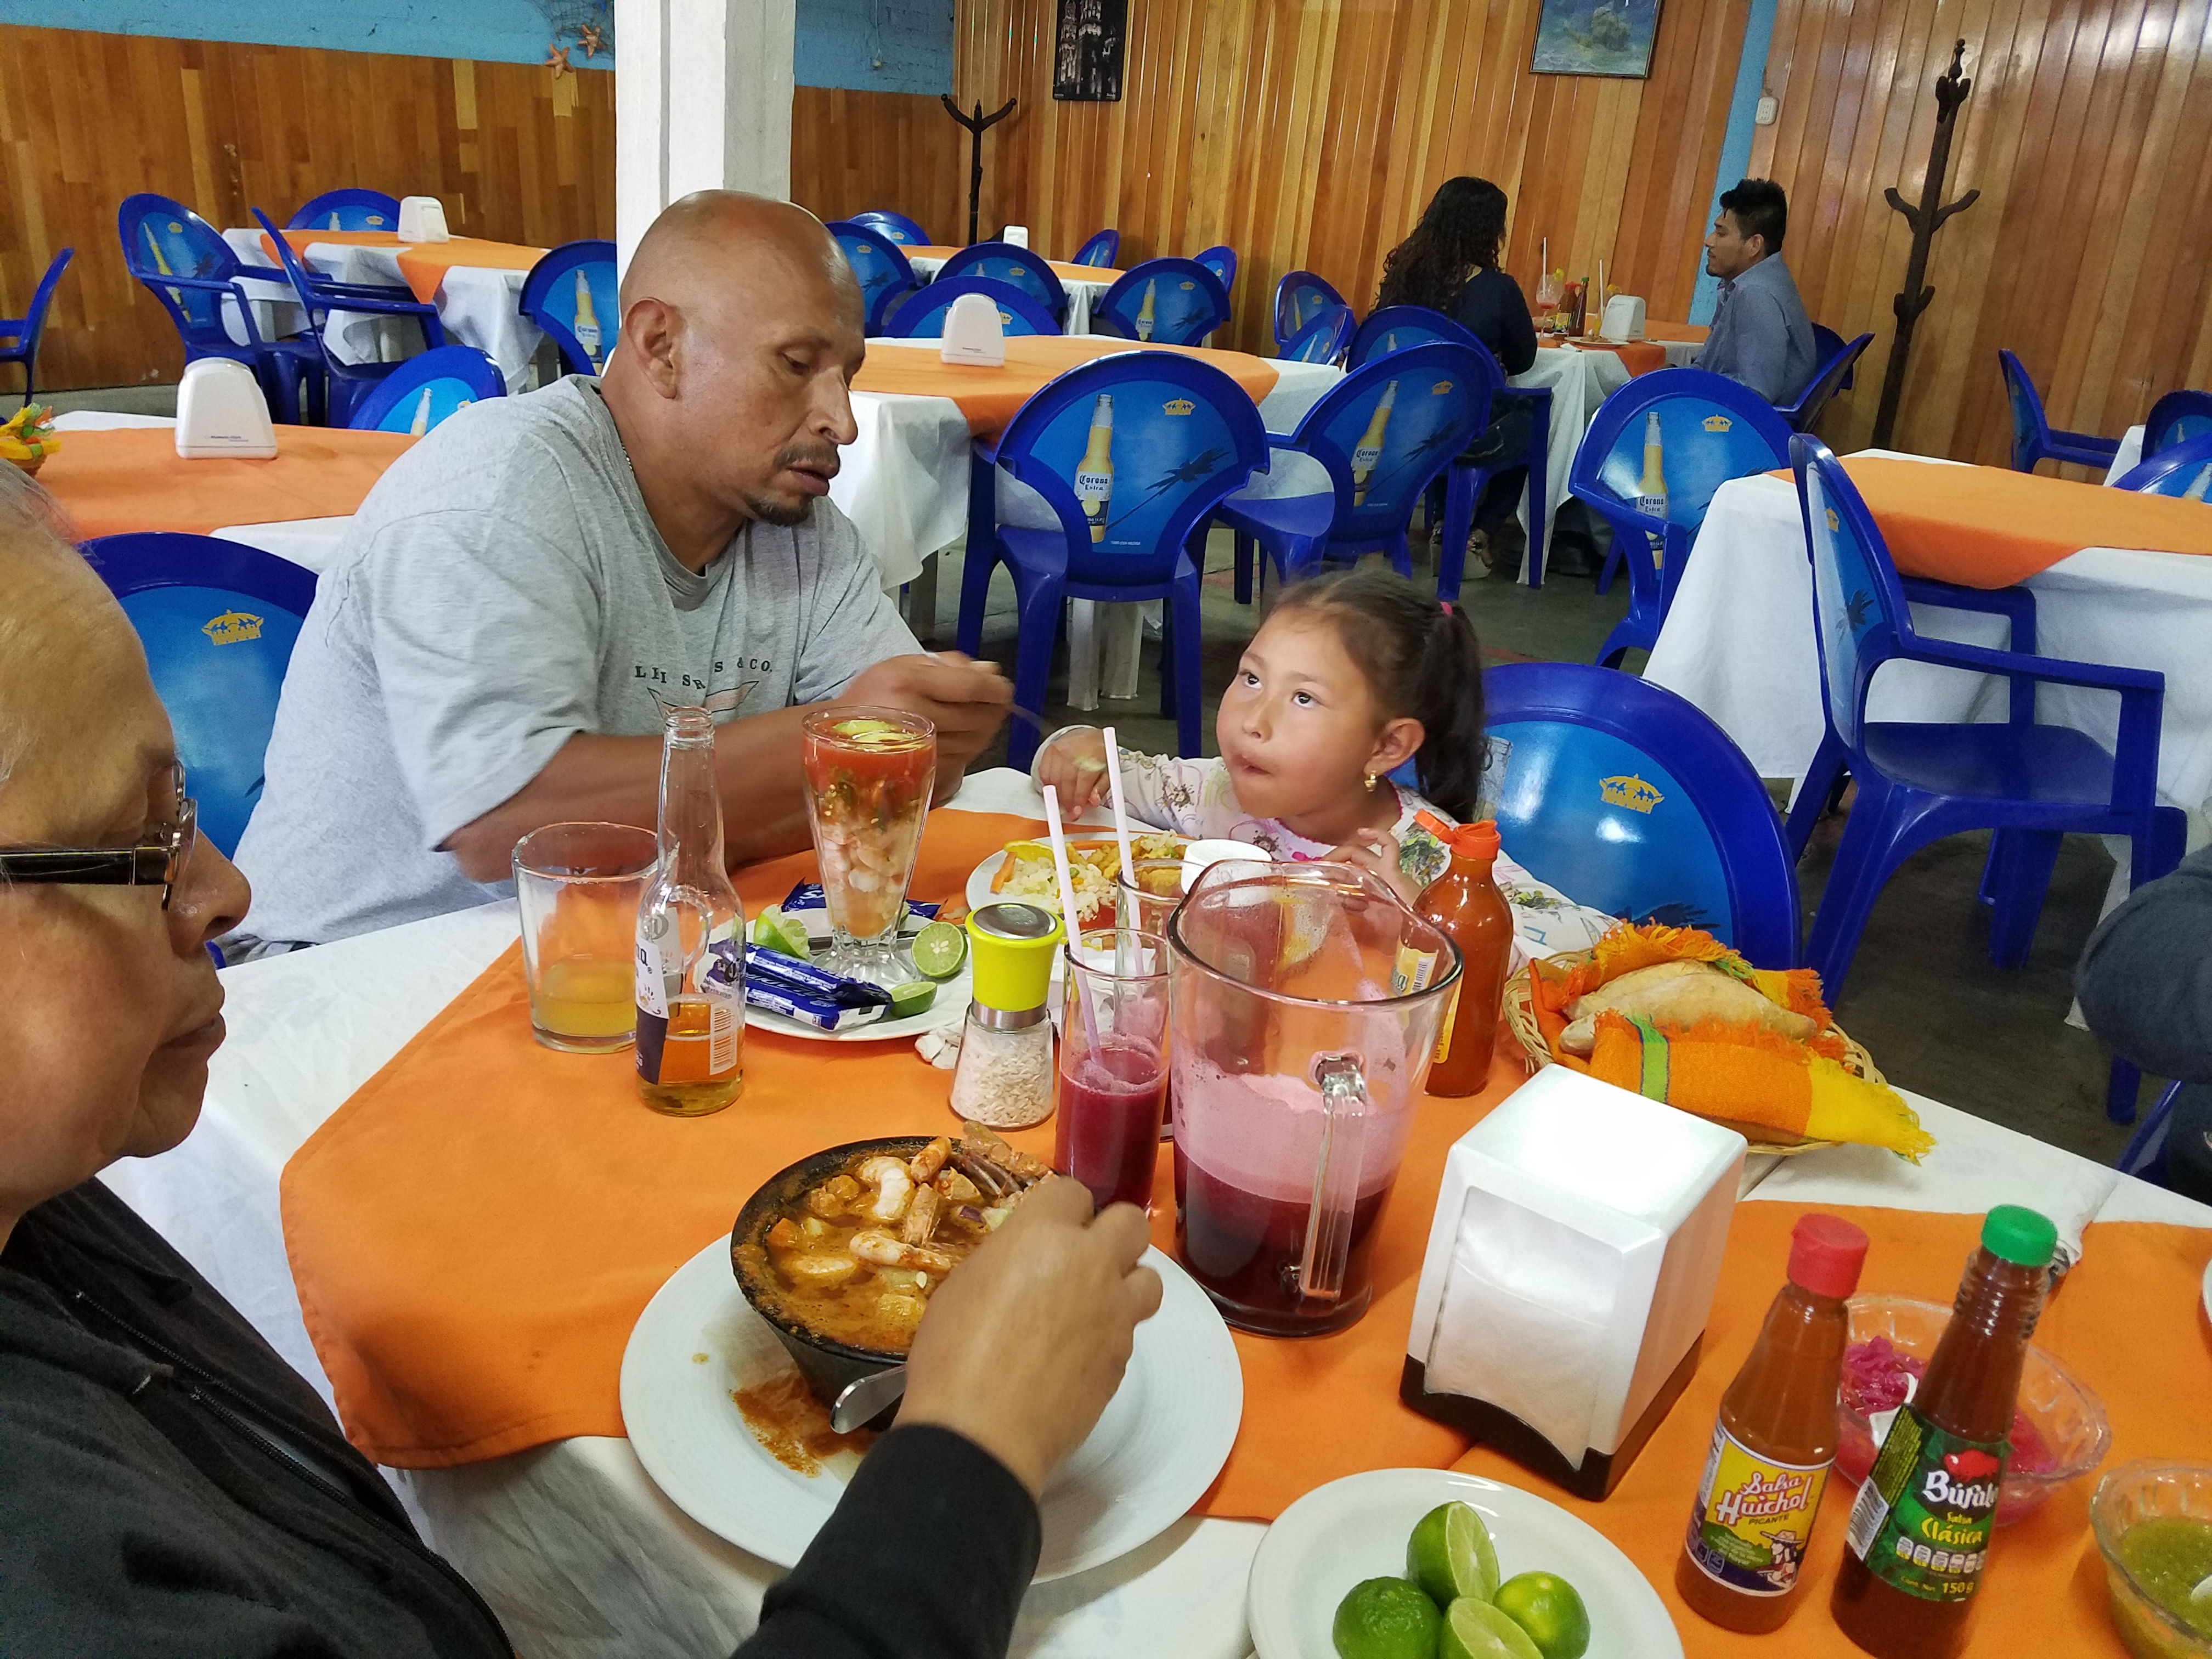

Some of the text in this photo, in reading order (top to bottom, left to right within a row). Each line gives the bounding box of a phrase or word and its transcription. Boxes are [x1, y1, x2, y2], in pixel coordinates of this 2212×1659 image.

[1079, 475, 1108, 486] Corona
[1640, 496, 1664, 506] Corona
[1740, 1471, 1802, 1496] Salsa
[1716, 1476, 1813, 1526] Huichol
[1748, 1514, 1790, 1525] PICANTE
[1921, 1517, 1983, 1545] Clásica
